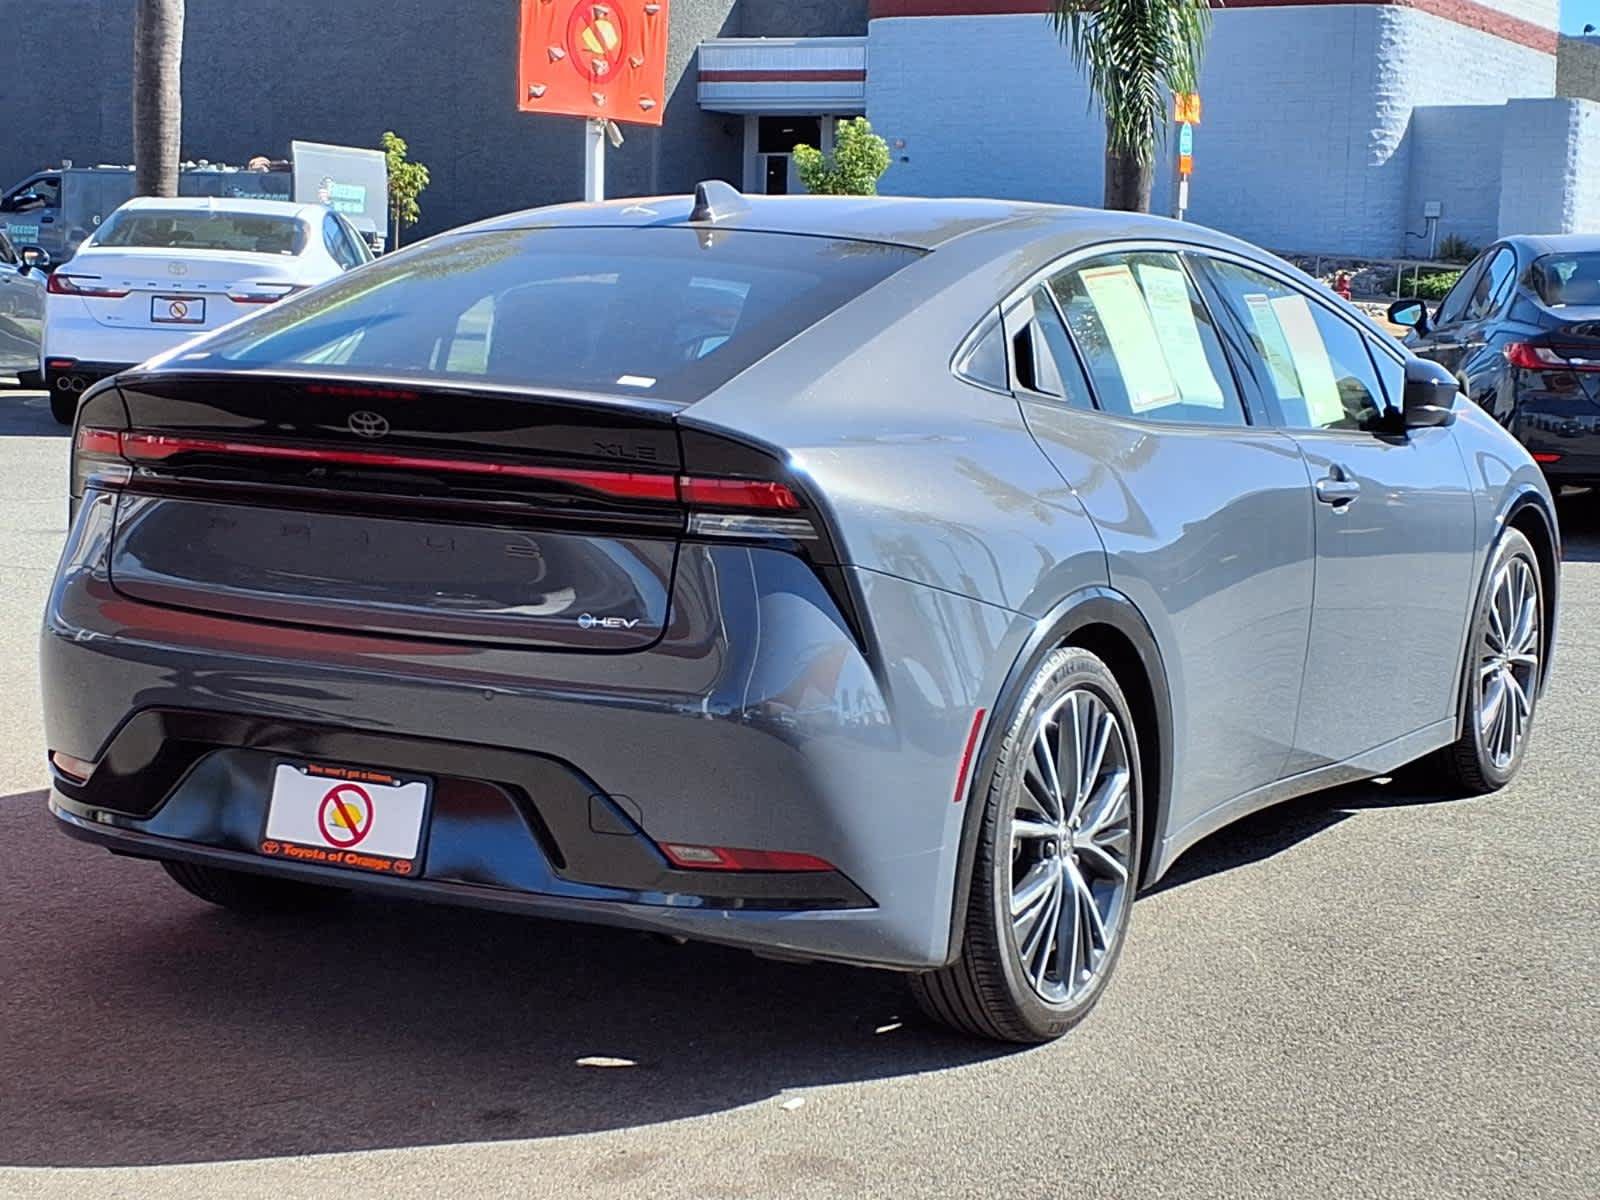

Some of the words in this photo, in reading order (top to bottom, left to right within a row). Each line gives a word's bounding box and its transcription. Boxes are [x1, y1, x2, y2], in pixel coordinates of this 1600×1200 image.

[592, 440, 657, 461] XLE
[592, 616, 640, 629] HEV
[282, 843, 326, 861] Toyota
[328, 851, 342, 863] of
[345, 854, 392, 871] Orange
